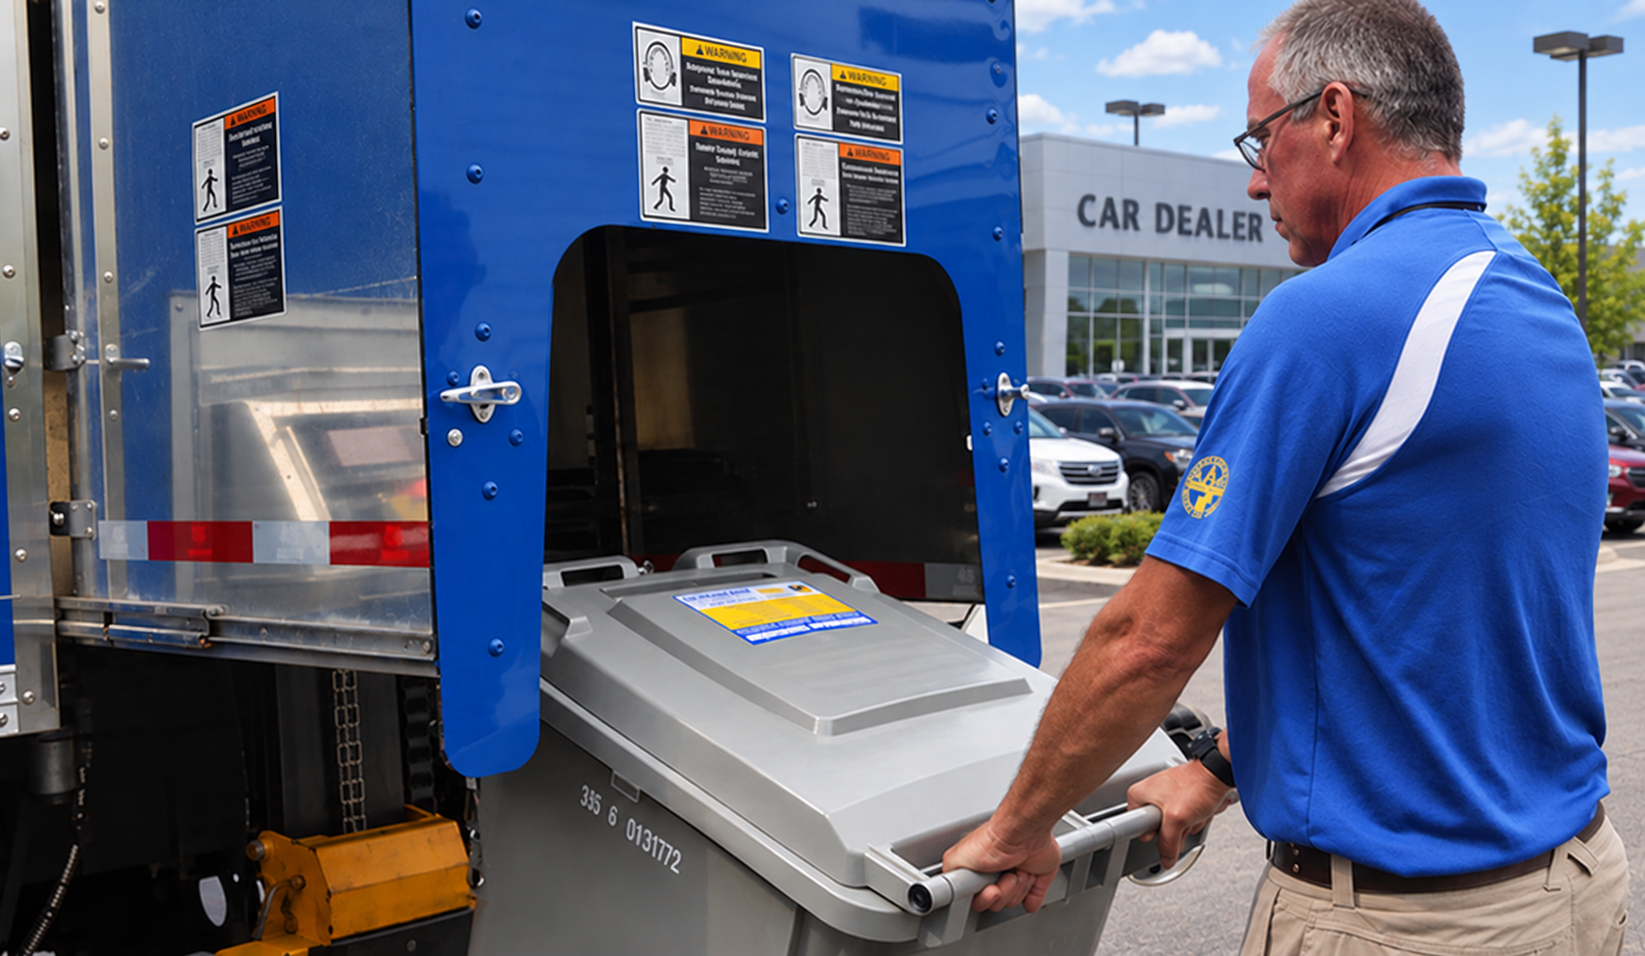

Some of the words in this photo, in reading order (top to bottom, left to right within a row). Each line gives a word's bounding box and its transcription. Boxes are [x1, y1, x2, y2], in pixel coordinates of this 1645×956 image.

[704, 45, 747, 63] WARNING
[848, 70, 887, 86] WARNING
[708, 127, 750, 141] WARNING
[855, 148, 890, 162] WARNING
[1077, 193, 1141, 232] CAR
[1155, 202, 1263, 243] DEALER
[608, 805, 618, 827] 6
[626, 817, 682, 875] 0131772
